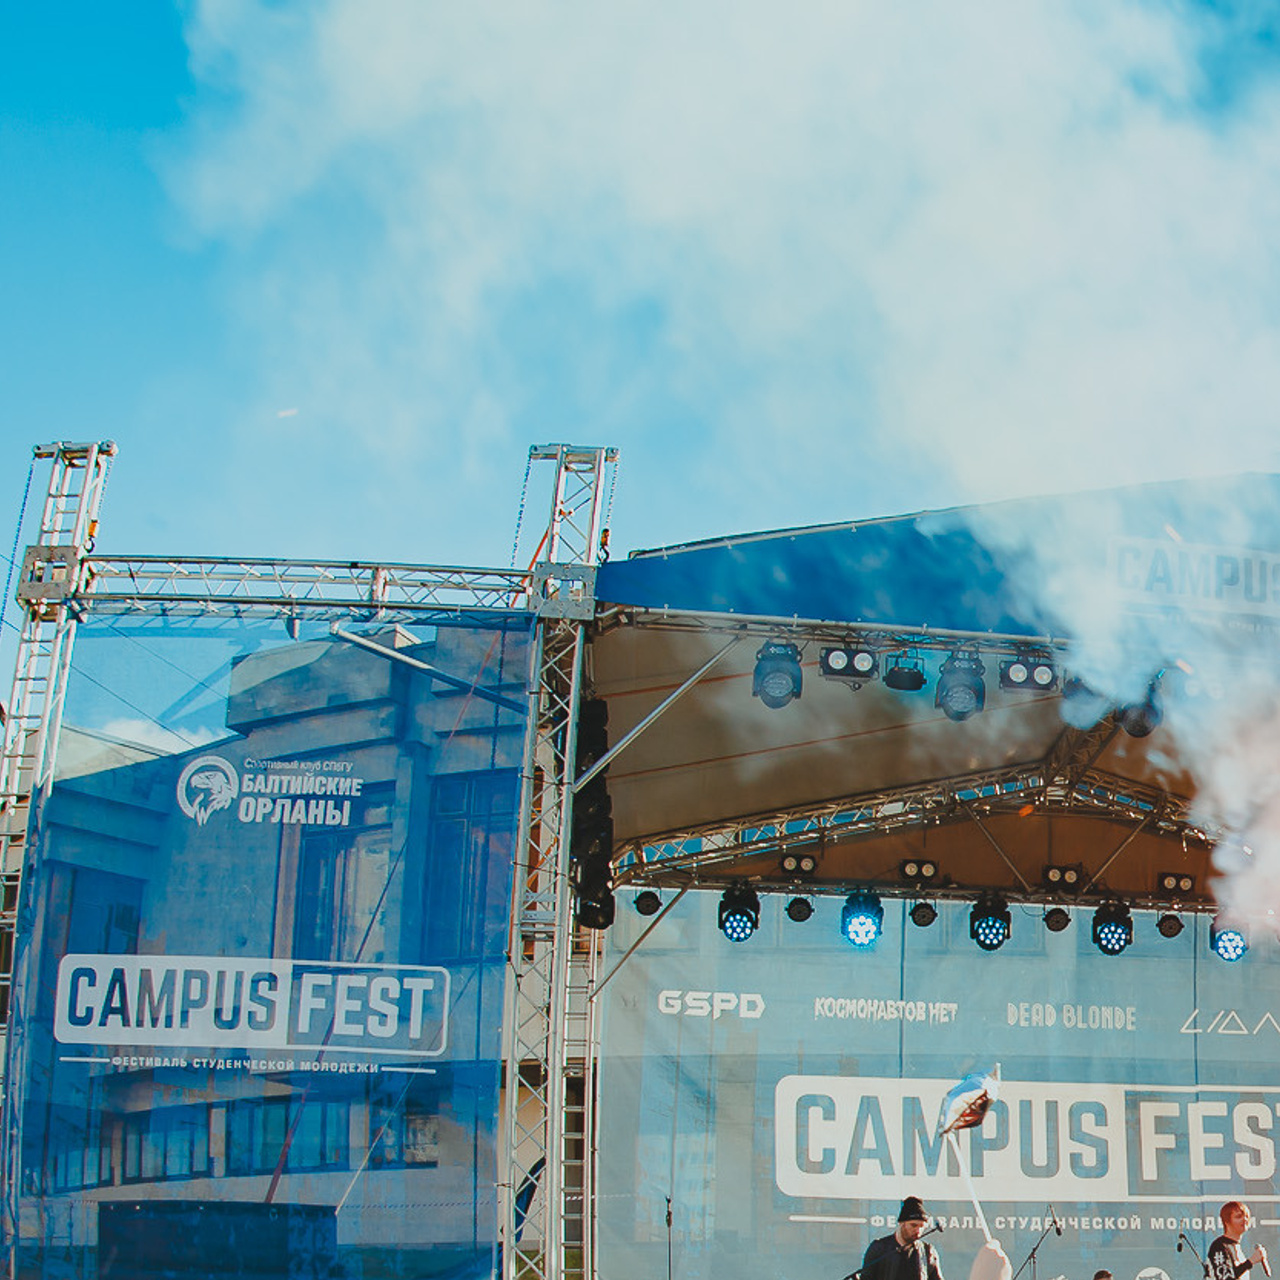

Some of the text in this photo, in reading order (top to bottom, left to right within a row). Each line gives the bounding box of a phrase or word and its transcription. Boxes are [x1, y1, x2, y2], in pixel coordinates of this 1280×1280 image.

[241, 772, 364, 796] БАЛТИЙСКИЕ
[238, 796, 351, 826] ОРЛАНЫ
[67, 967, 434, 1039] CAMPUS FEST
[657, 990, 766, 1020] GSPD
[814, 997, 958, 1025] КОСМОНАВТОВ НЕТ
[1007, 1002, 1137, 1030] DEAD BLONDE
[111, 1056, 380, 1073] ФЕСТИВАЛЬ СТУДЕНЧЕСКОЙ МОЛОДЕЖИ
[795, 1093, 1108, 1179] CAMPUS
[870, 1215, 986, 1230] ФЕИВАЛЬ
[995, 1214, 1142, 1231] СТУДЕНЧЕСКОЙ
